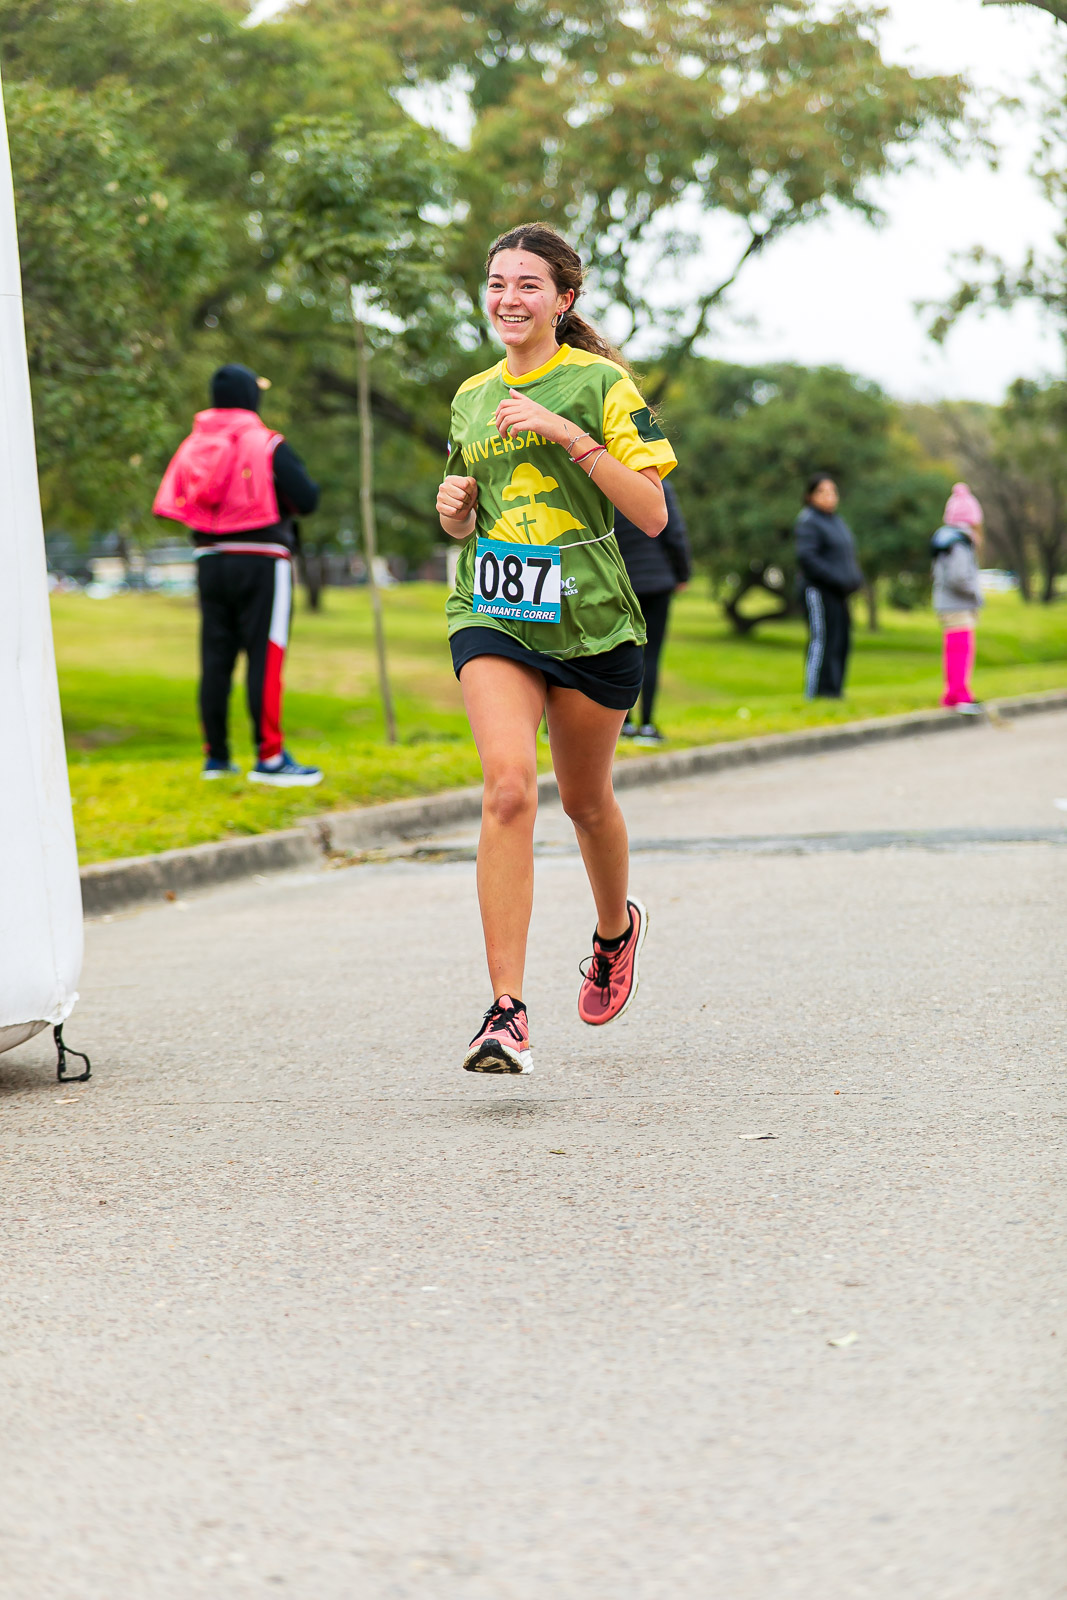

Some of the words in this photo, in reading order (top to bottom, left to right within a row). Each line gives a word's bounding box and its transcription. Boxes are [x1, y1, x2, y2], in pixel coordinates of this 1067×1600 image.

[479, 551, 552, 606] 087
[477, 604, 522, 617] DIAMANTE
[523, 609, 556, 620] CORRE
